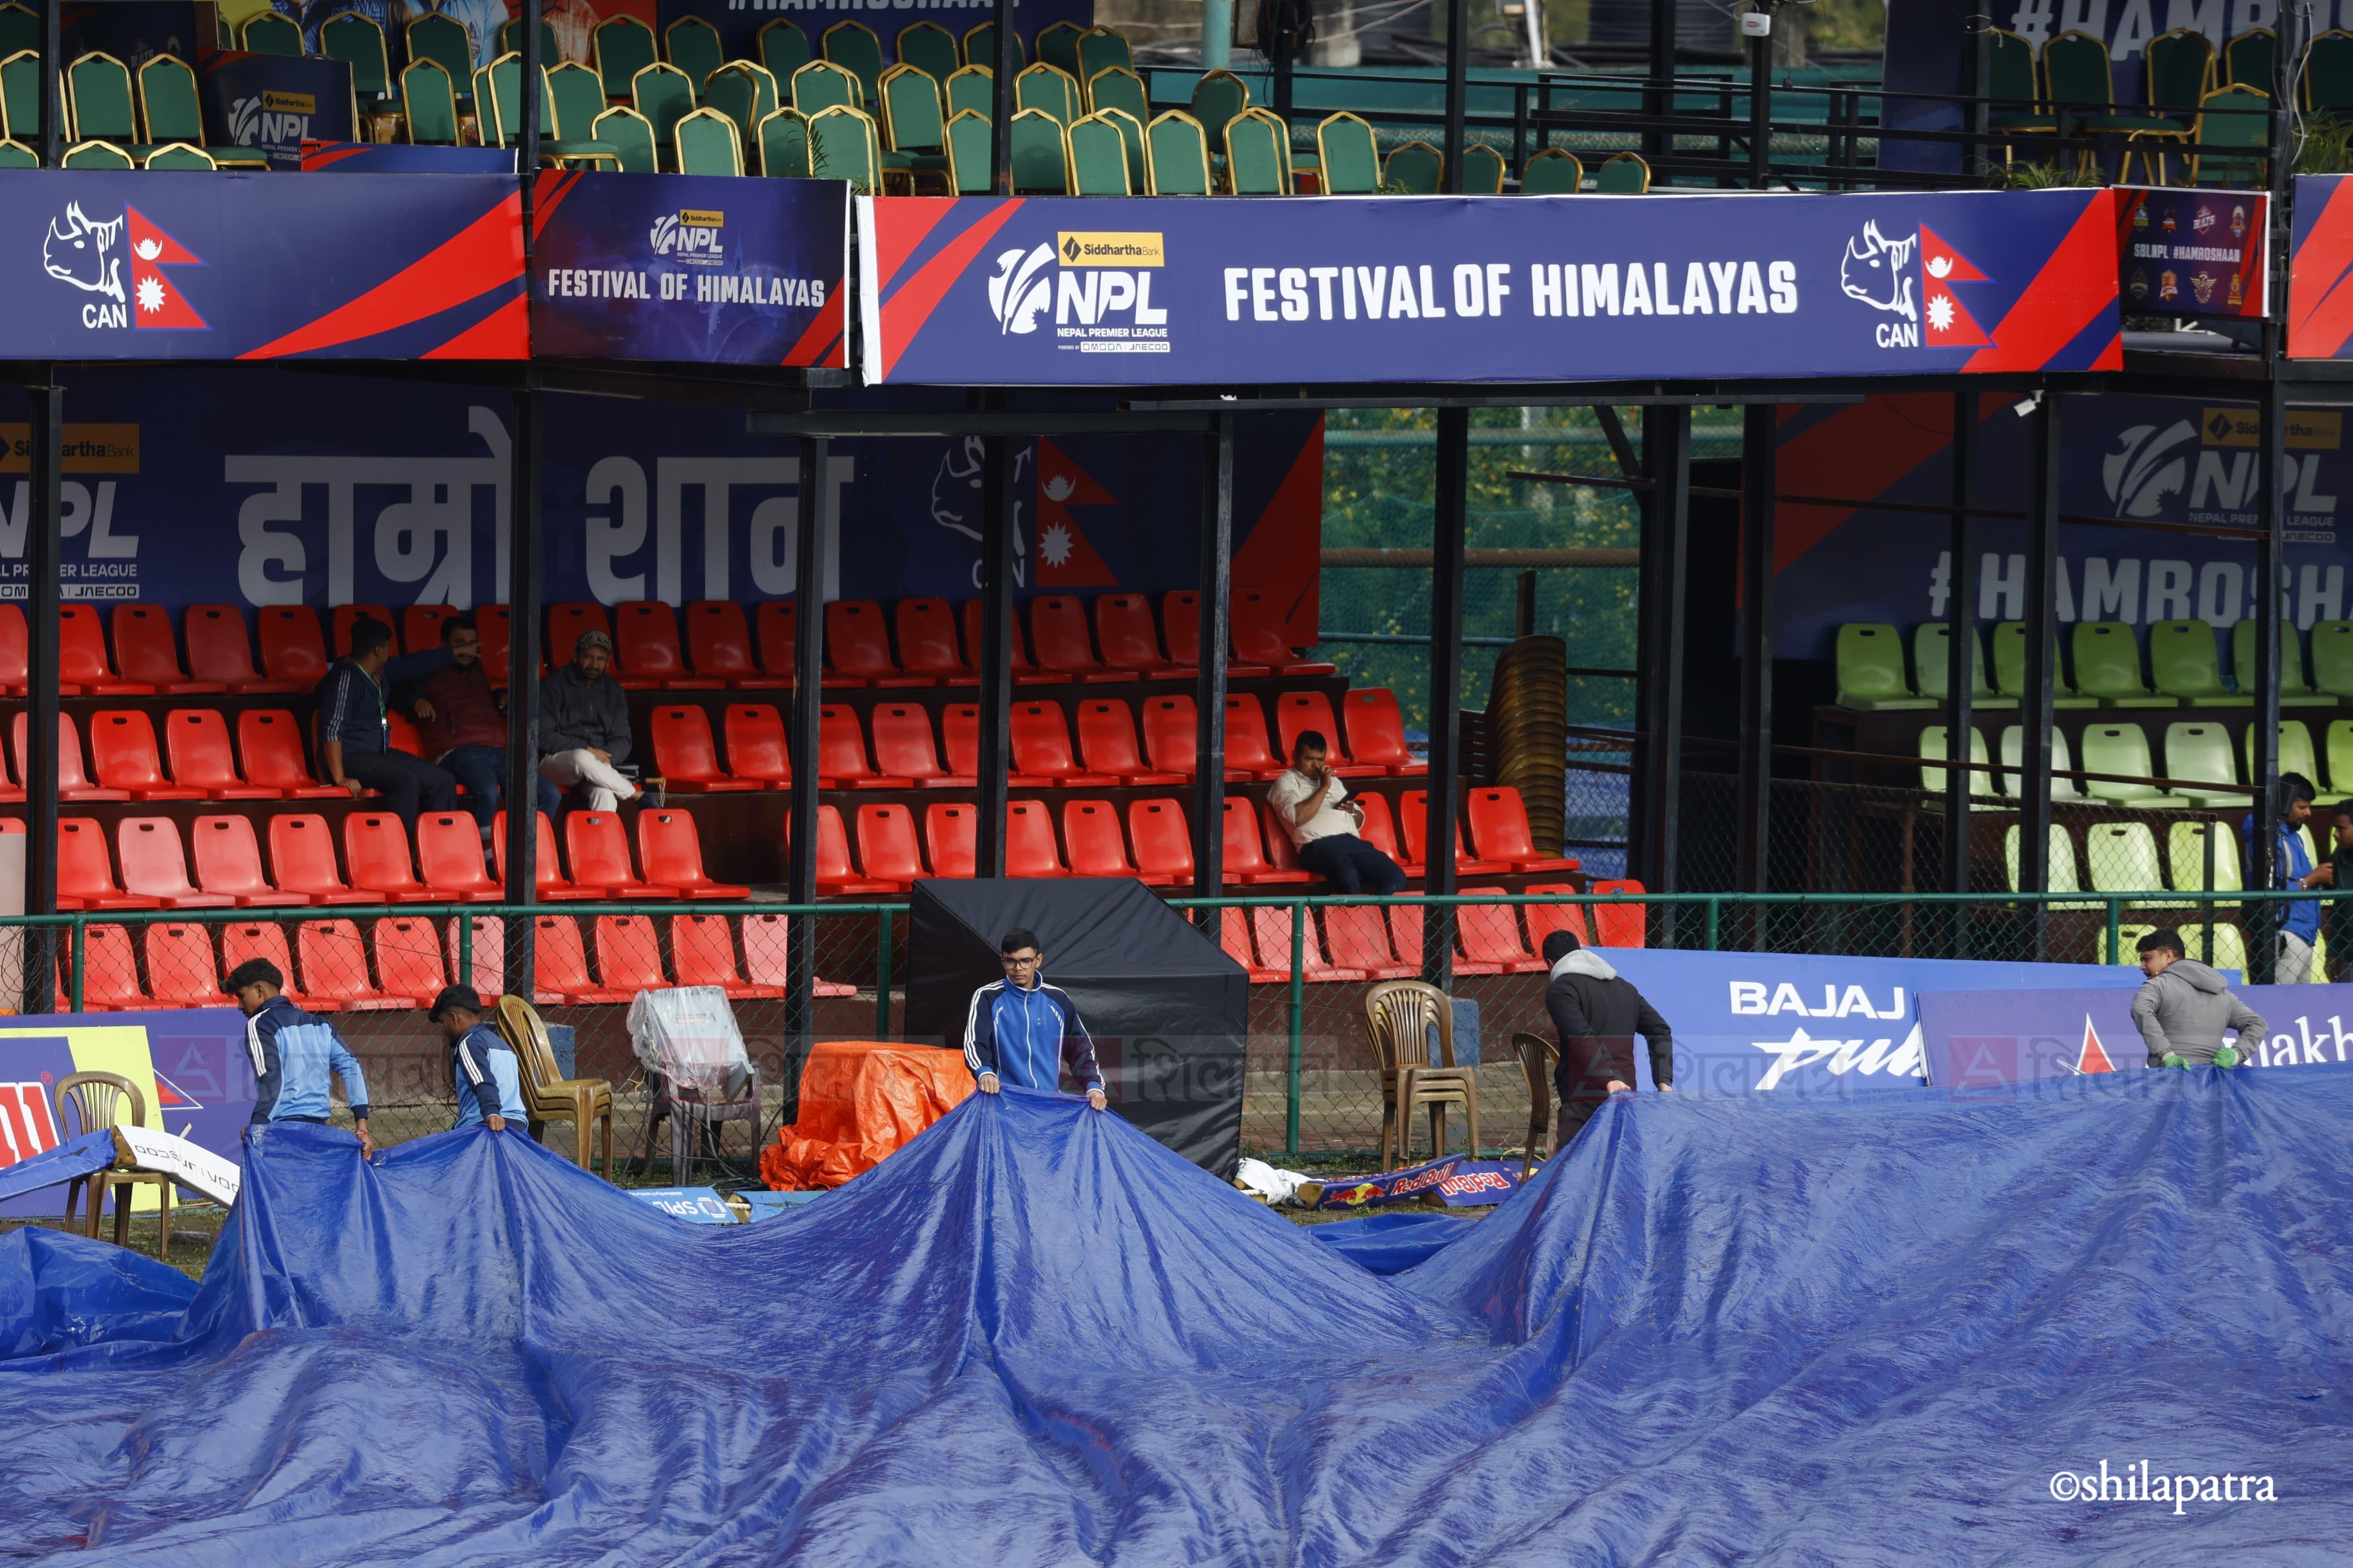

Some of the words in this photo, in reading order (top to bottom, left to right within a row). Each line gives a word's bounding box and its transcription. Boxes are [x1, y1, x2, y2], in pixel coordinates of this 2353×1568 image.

[261, 113, 317, 144] NPL
[676, 227, 723, 253] NPL
[1084, 244, 1141, 256] Siddhartha
[1143, 247, 1160, 256] Bank
[2134, 243, 2169, 259] SBLNPL
[2173, 246, 2240, 262] #HAMROSHAAN
[549, 269, 650, 299] FESTIVAL
[661, 273, 688, 301] OF
[697, 275, 824, 307] HIMALAYAS
[1055, 271, 1167, 325] NPL
[1224, 265, 1445, 321] FESTIVAL
[1453, 264, 1511, 317] OF
[1531, 261, 1798, 318] HIMALAYAS
[82, 304, 127, 329] CAN
[1057, 328, 1087, 338] NEPAL
[1089, 328, 1130, 338] PREMIER
[1132, 328, 1167, 338] LEAGUE
[1876, 323, 1919, 348] CAN
[15, 440, 106, 457] Siartha
[107, 444, 134, 457] Bank
[2189, 512, 2227, 523] NEPAL
[2287, 516, 2335, 526] LEAGUE
[586, 456, 854, 608] शान
[13, 564, 76, 577] PRER
[81, 564, 137, 577] LEAGUE
[972, 558, 1025, 589] CN
[75, 586, 136, 597] JAECOO
[1730, 981, 1906, 1020] BAJAJ
[1390, 1170, 1424, 1196] Red
[1420, 1162, 1455, 1187] Bull
[1438, 1176, 1476, 1196] Bull
[1467, 1172, 1511, 1193] Red
[652, 1200, 699, 1215] SPIL
